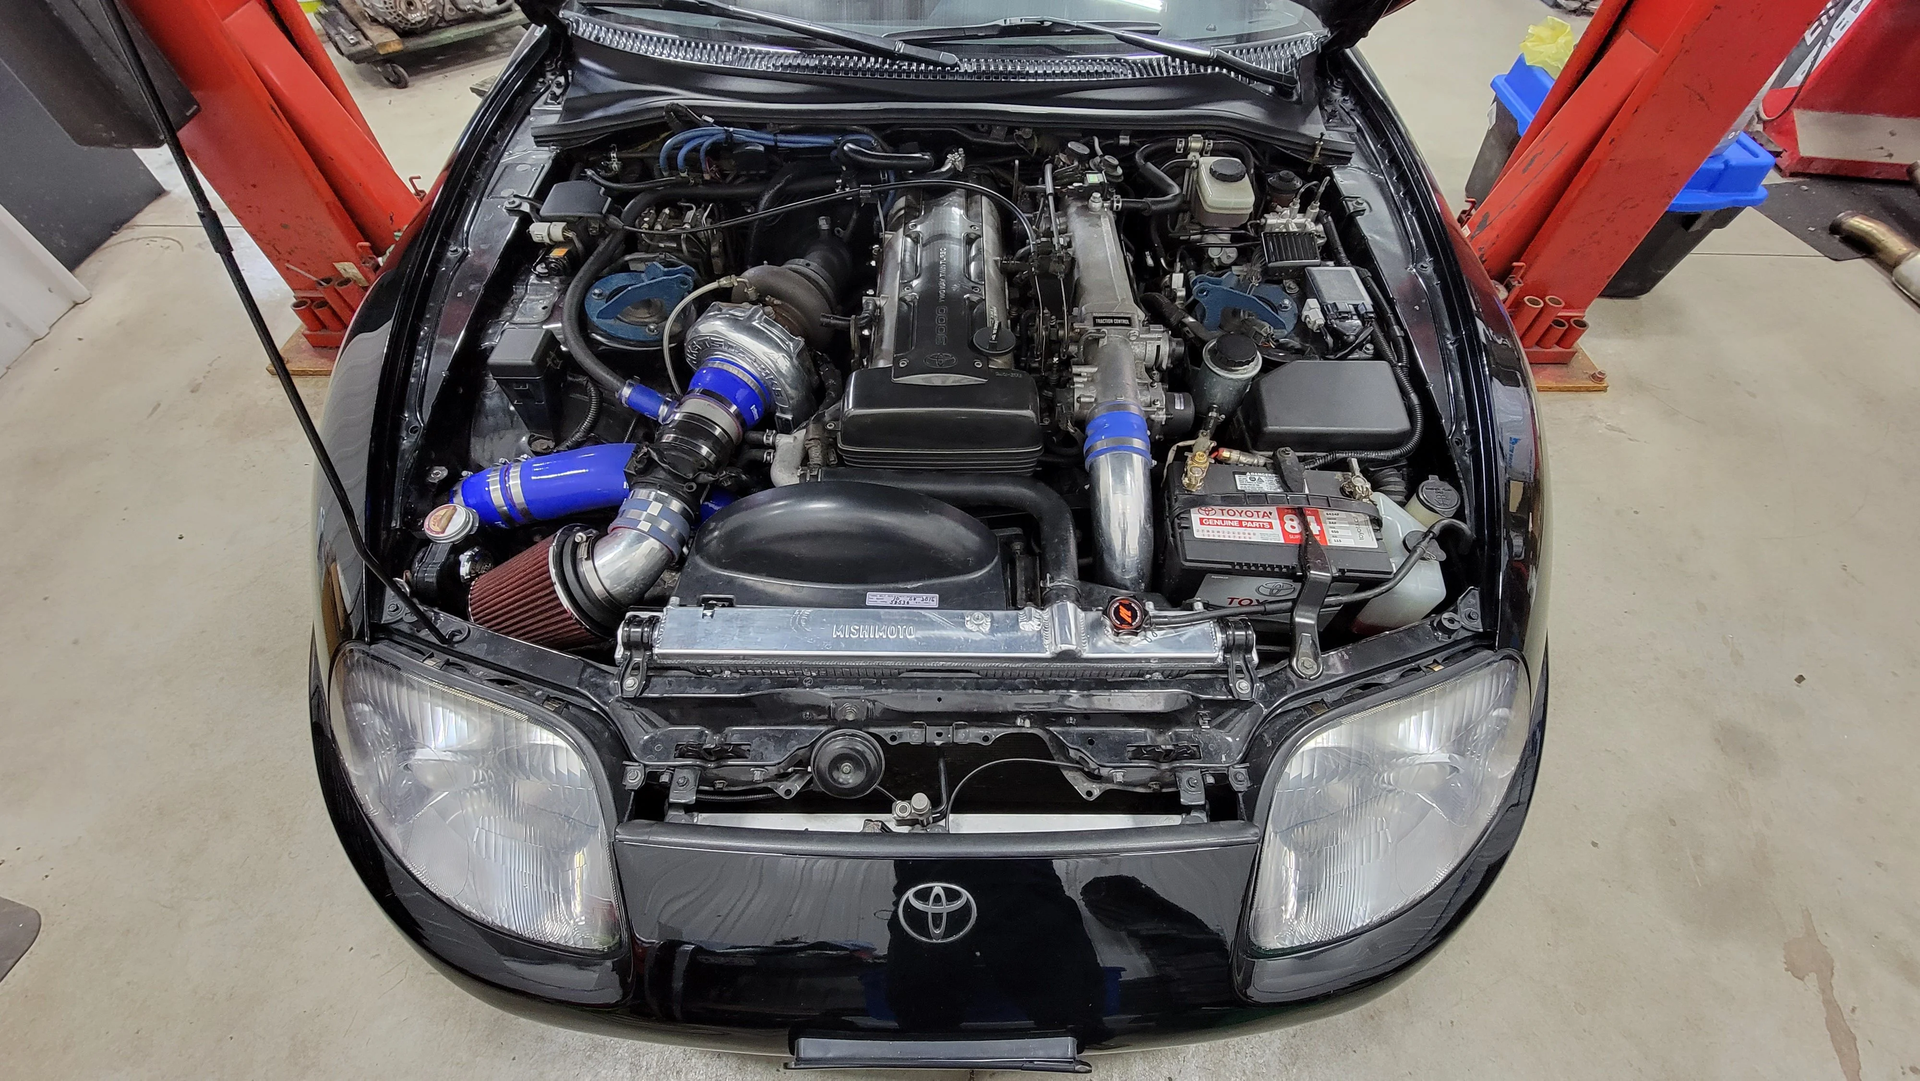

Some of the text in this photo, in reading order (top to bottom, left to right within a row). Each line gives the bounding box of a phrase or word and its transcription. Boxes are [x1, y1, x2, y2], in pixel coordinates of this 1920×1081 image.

[1218, 508, 1271, 519] TOYOTA
[1202, 518, 1270, 529] GENUINE PARTS
[832, 624, 916, 639] MISHIMOTO
